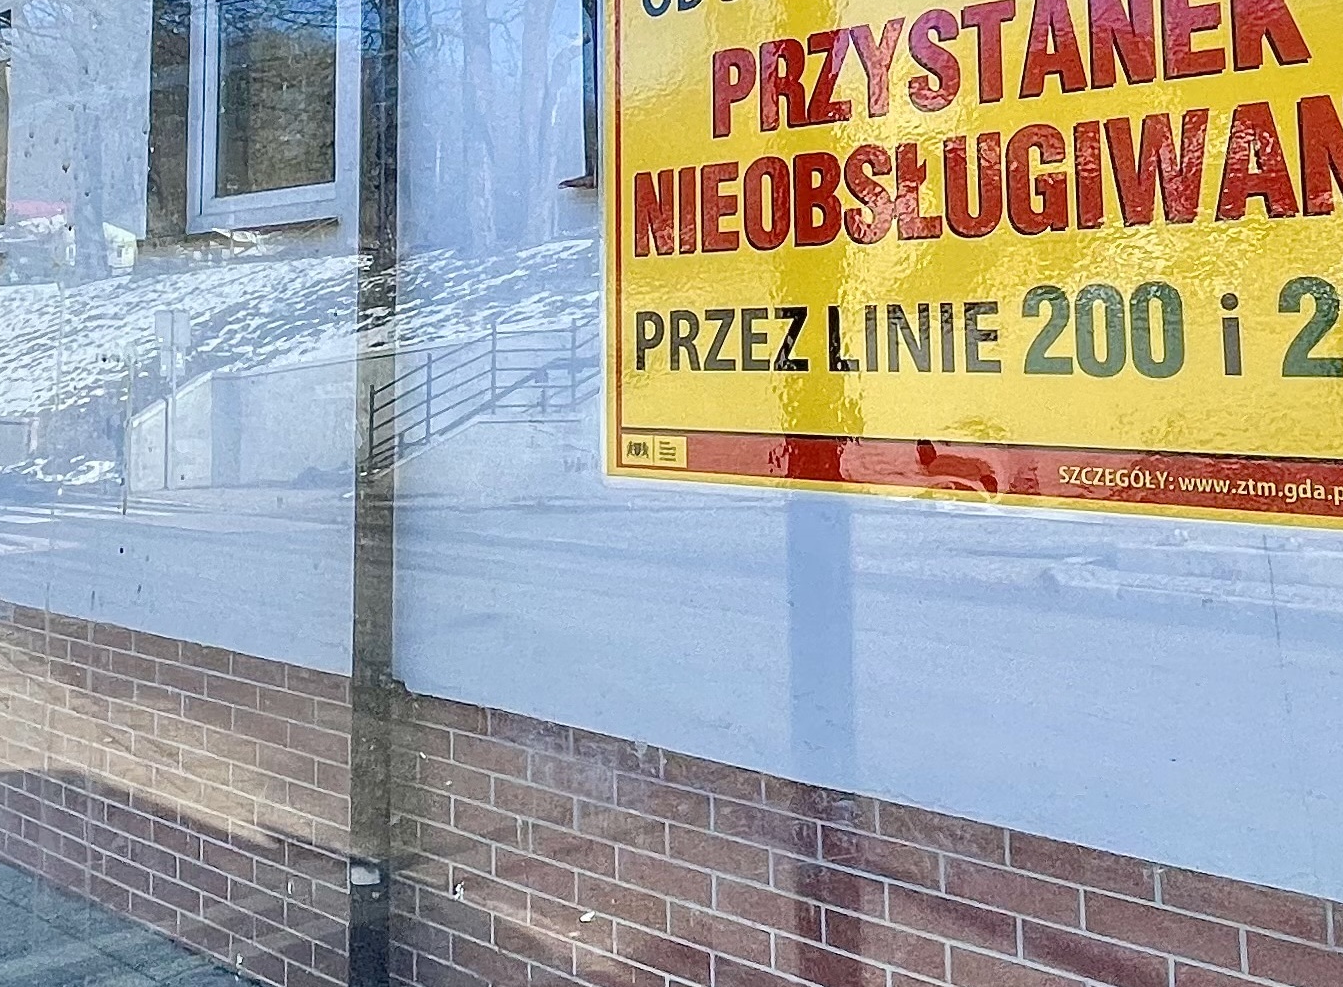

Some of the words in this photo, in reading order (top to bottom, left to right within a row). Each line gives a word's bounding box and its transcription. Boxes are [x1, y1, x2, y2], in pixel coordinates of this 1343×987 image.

[634, 306, 809, 373] PRZEZ
[826, 300, 1002, 373] LINIE
[1022, 281, 1186, 378] 200
[1222, 293, 1243, 376] i
[1058, 465, 1175, 491] SZCZEGÓŁY:
